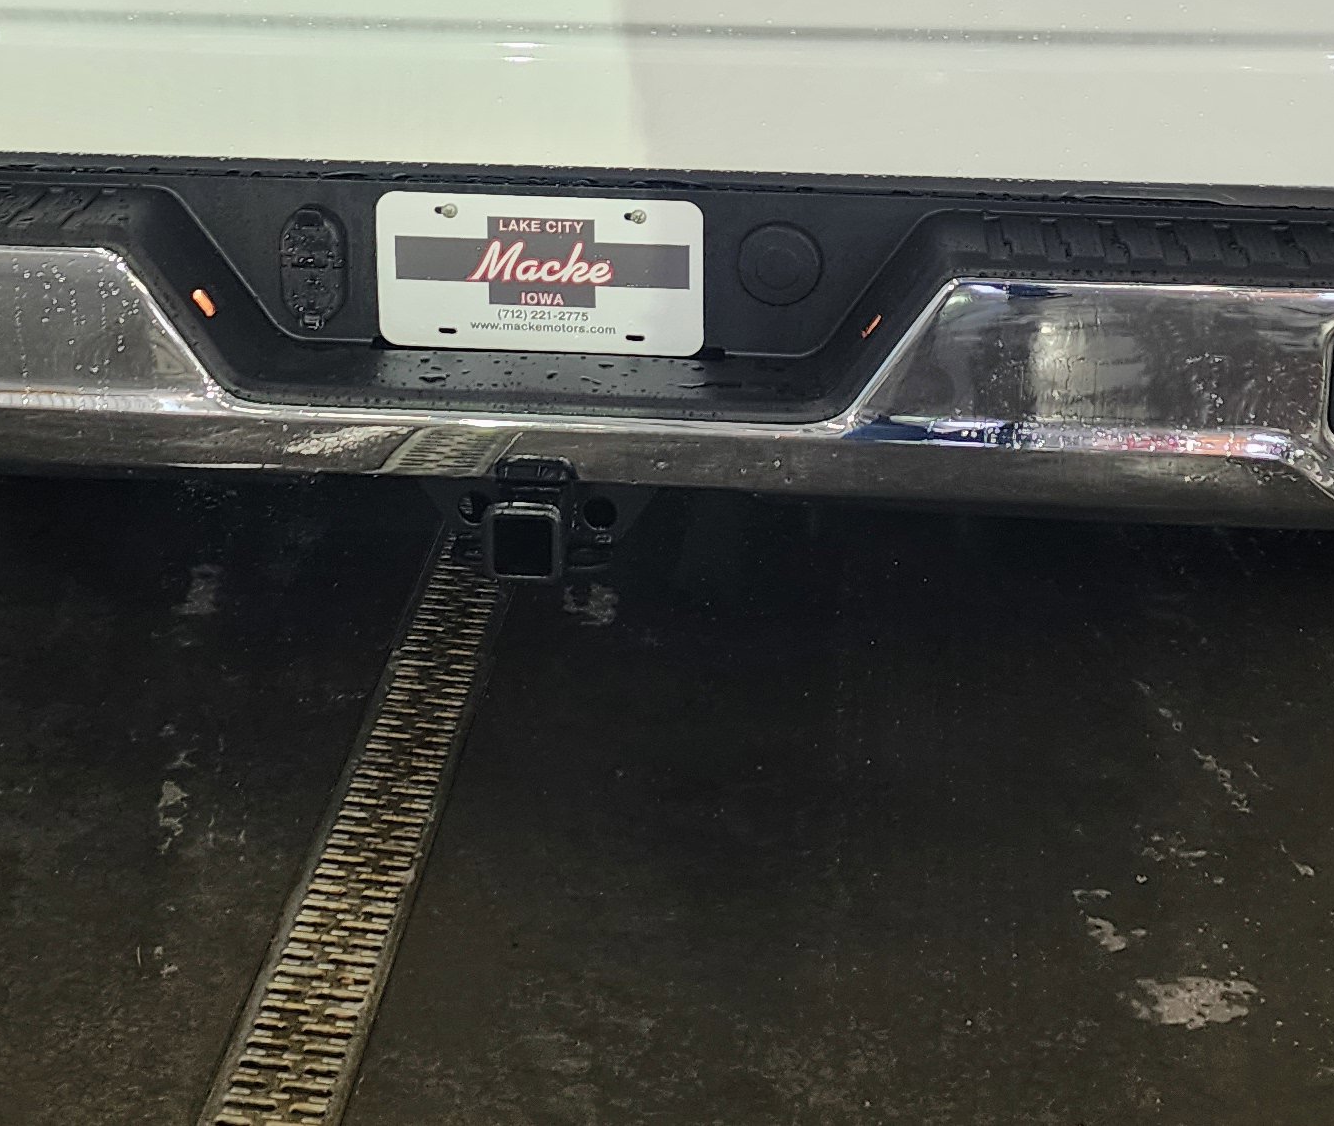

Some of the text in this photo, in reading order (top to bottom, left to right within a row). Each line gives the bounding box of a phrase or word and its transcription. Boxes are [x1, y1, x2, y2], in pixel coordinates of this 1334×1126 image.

[499, 219, 584, 234] LAKE CITY
[469, 240, 613, 283] Macke
[520, 291, 565, 306] IOWA
[497, 309, 589, 322] (712) 221-2775
[469, 321, 616, 335] www.mackemotors.com
